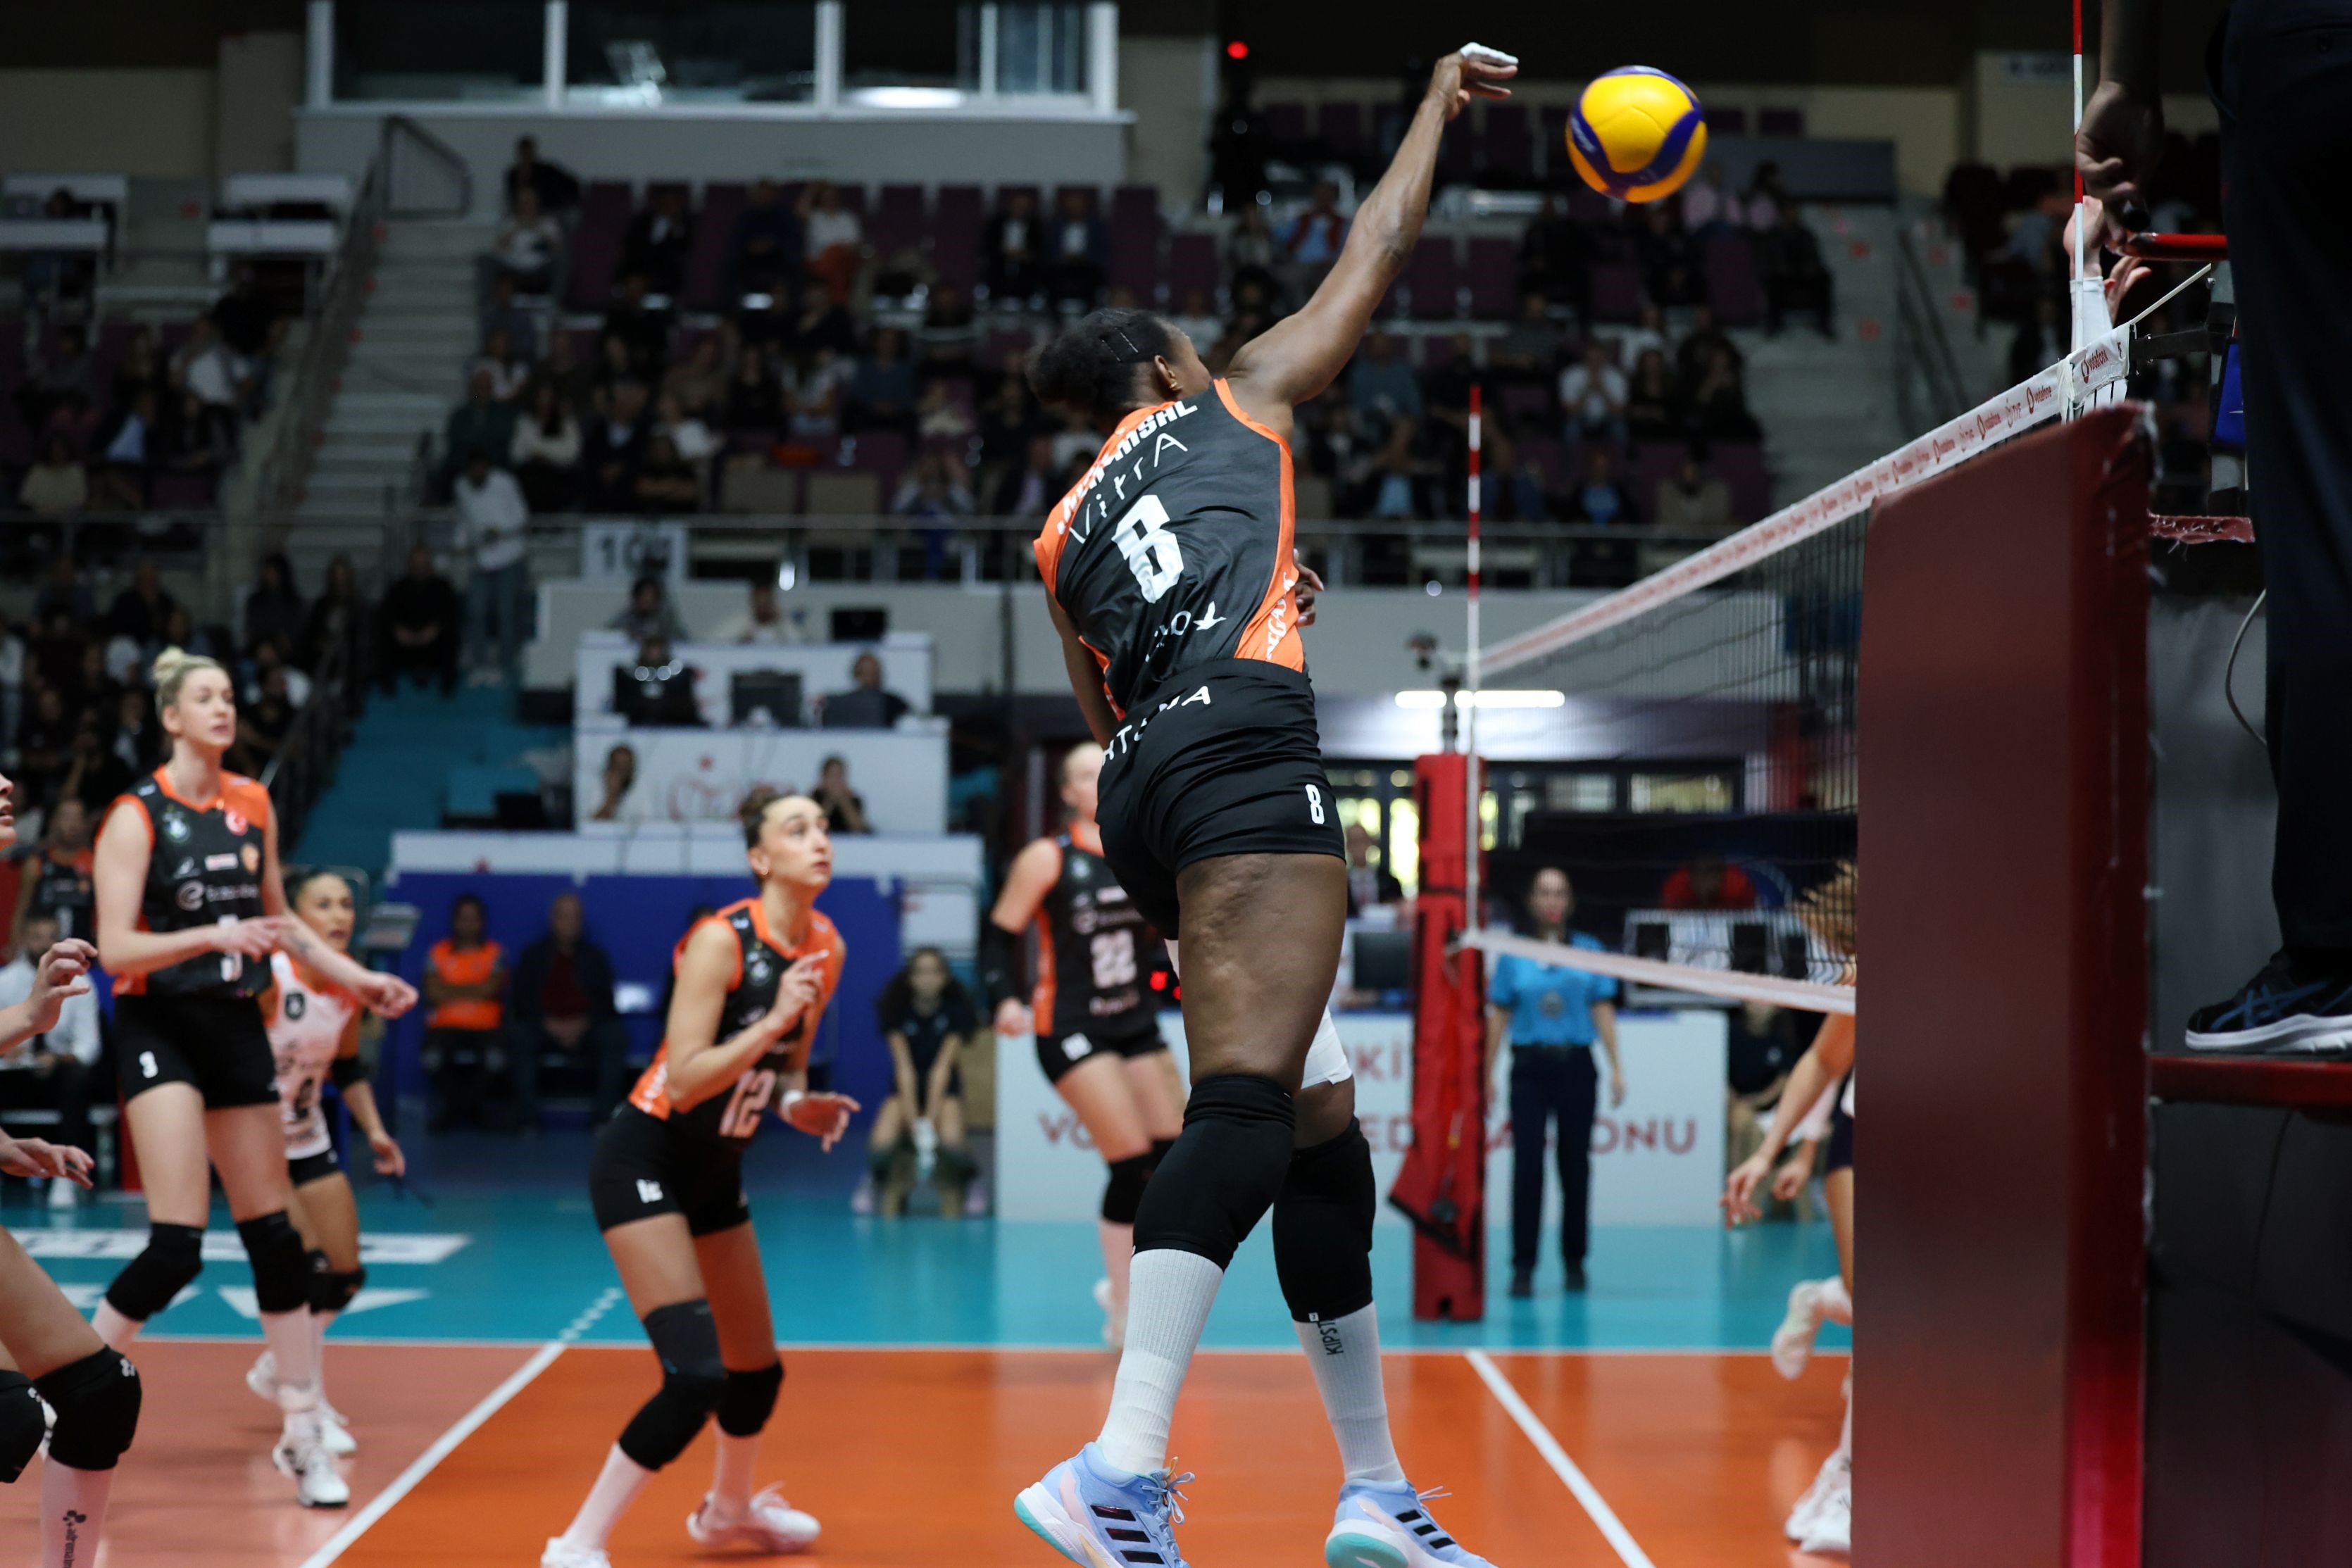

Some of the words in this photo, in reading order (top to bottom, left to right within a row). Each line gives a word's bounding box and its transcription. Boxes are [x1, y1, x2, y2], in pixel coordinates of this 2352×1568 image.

[1069, 433, 1188, 544] VitrA
[1111, 495, 1184, 603] 8
[1305, 784, 1325, 824] 8
[139, 1050, 158, 1078] 3
[718, 1067, 777, 1138] 12
[1317, 1321, 1344, 1355] KIPST
